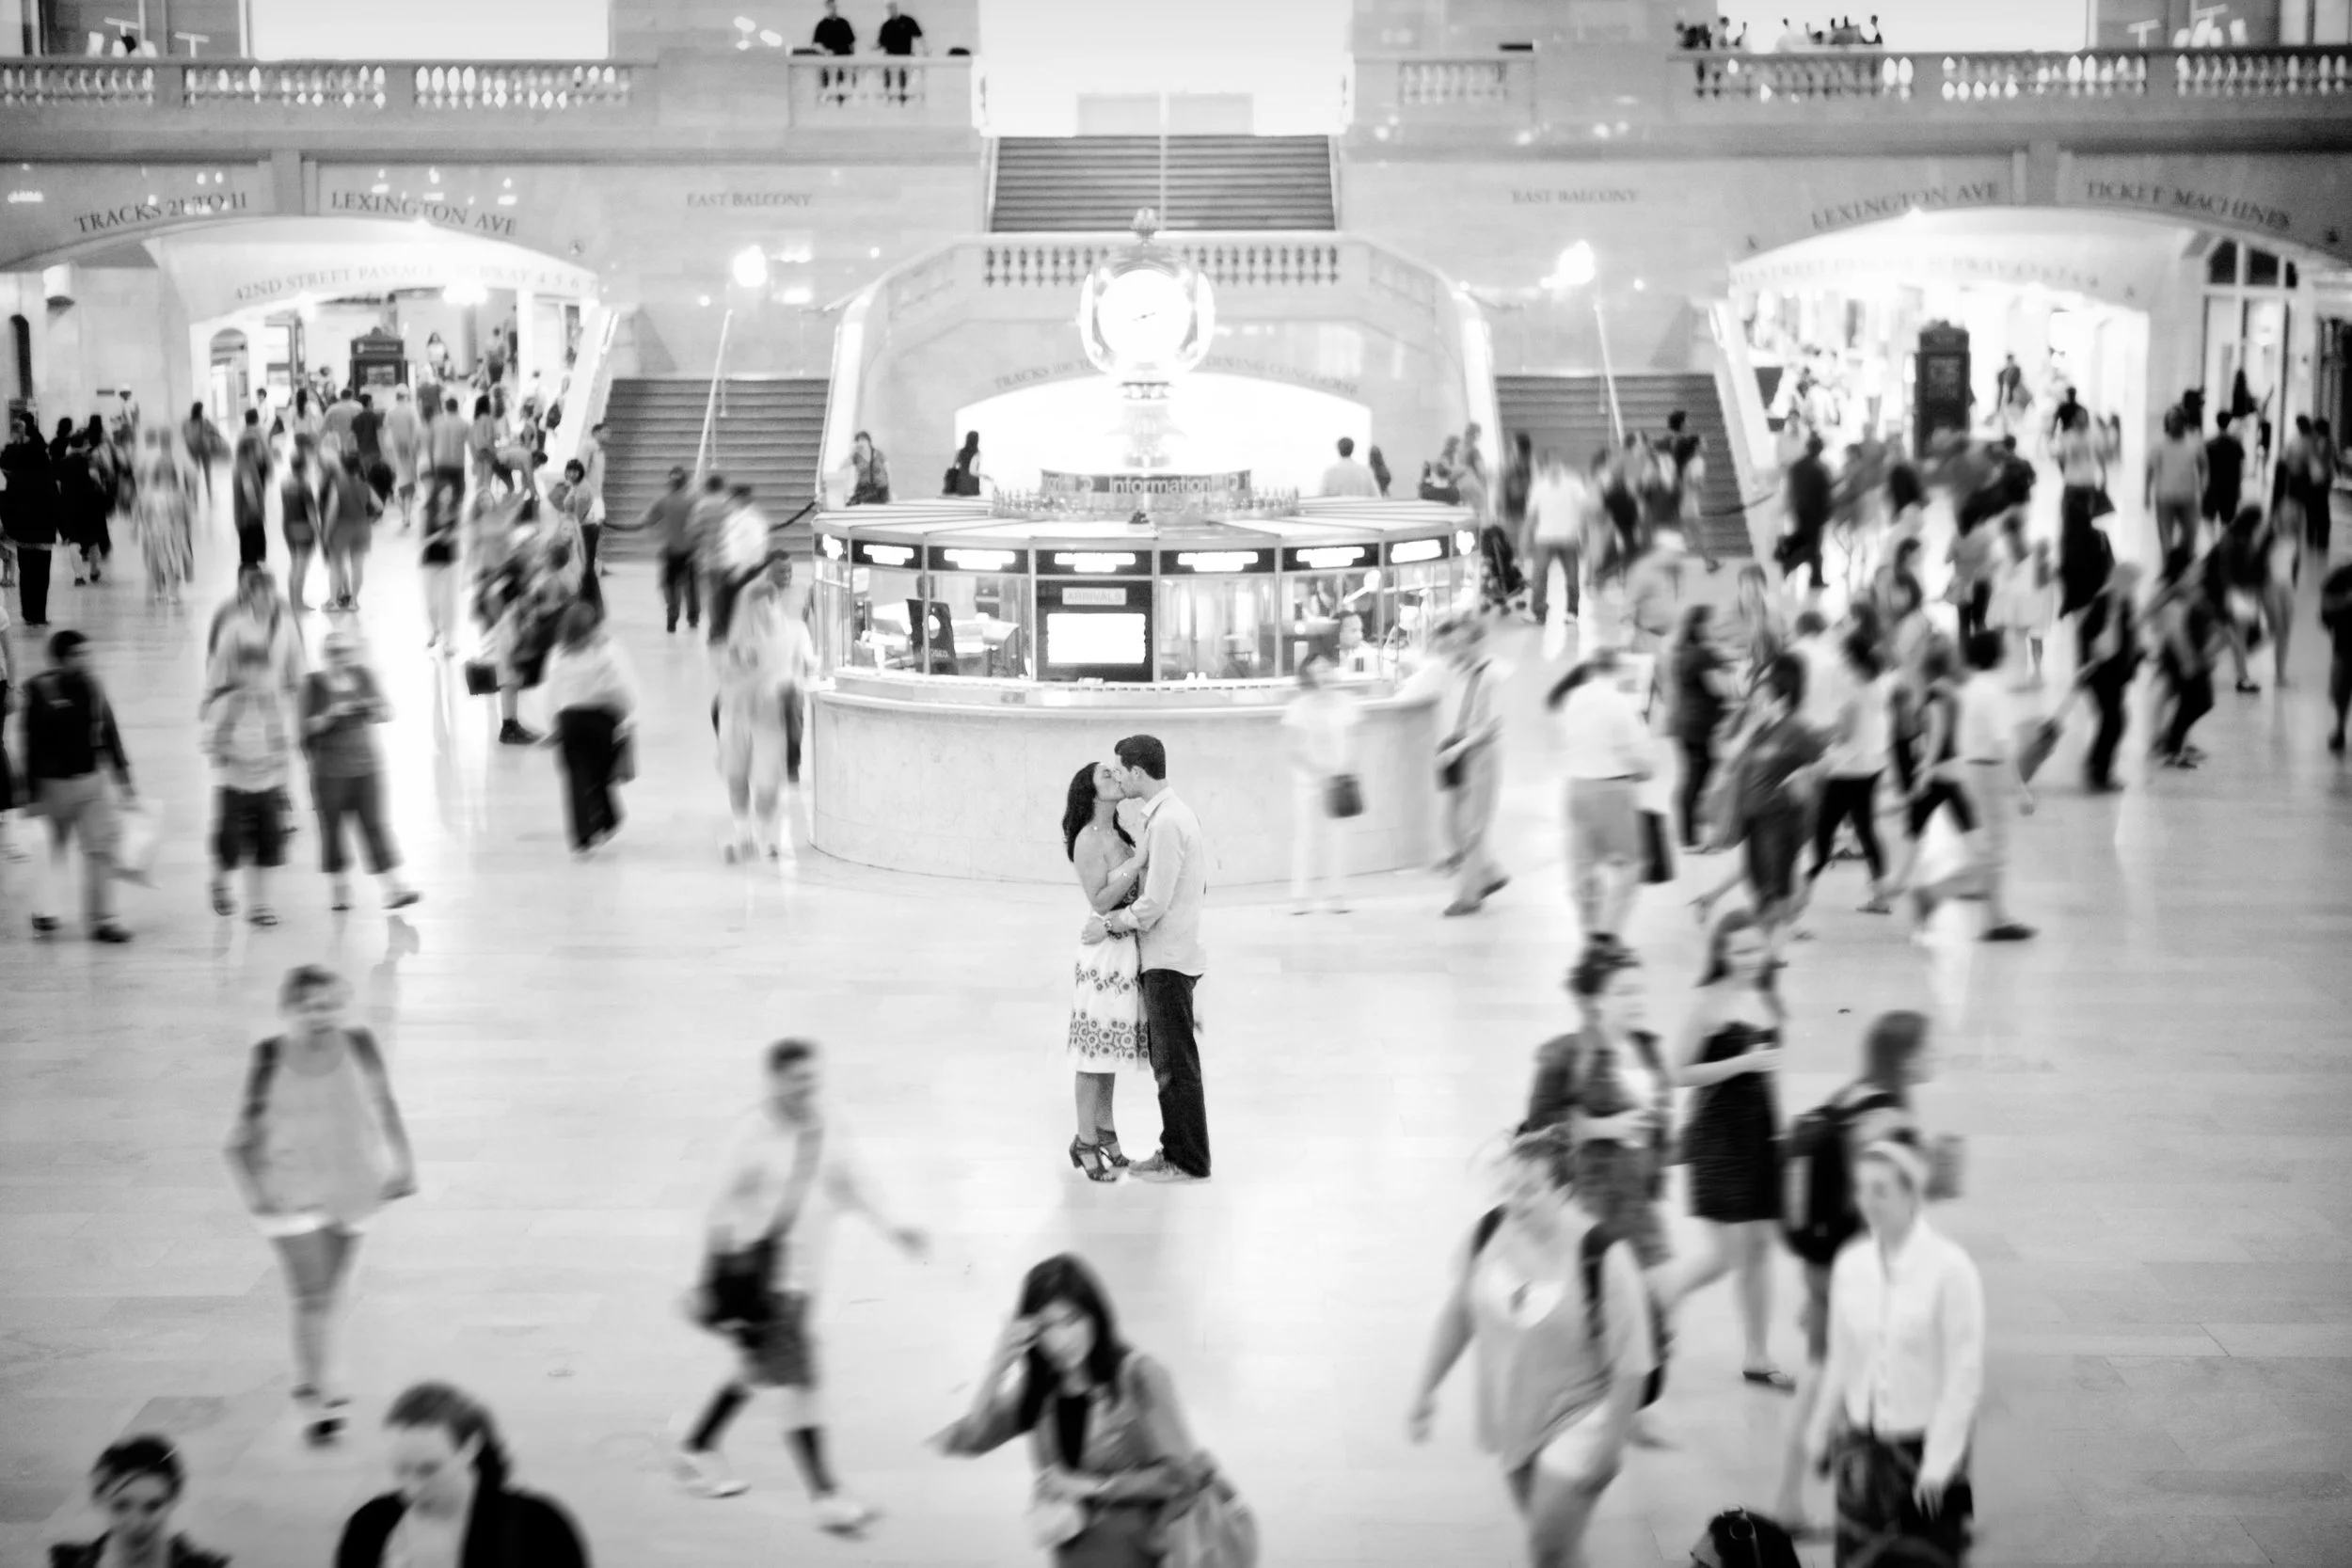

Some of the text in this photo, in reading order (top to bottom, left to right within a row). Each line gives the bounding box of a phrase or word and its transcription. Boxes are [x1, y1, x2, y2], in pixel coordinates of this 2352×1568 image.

[687, 191, 813, 208] EAST BALCONY
[1810, 182, 1998, 230] LEXINGTON AVE
[2085, 181, 2164, 204] TICKET
[73, 200, 162, 233] TRACKS
[331, 191, 517, 237] LEXINGTON AVE
[234, 277, 281, 301] 42ND
[286, 268, 351, 292] STREET
[1108, 475, 1212, 494] Information
